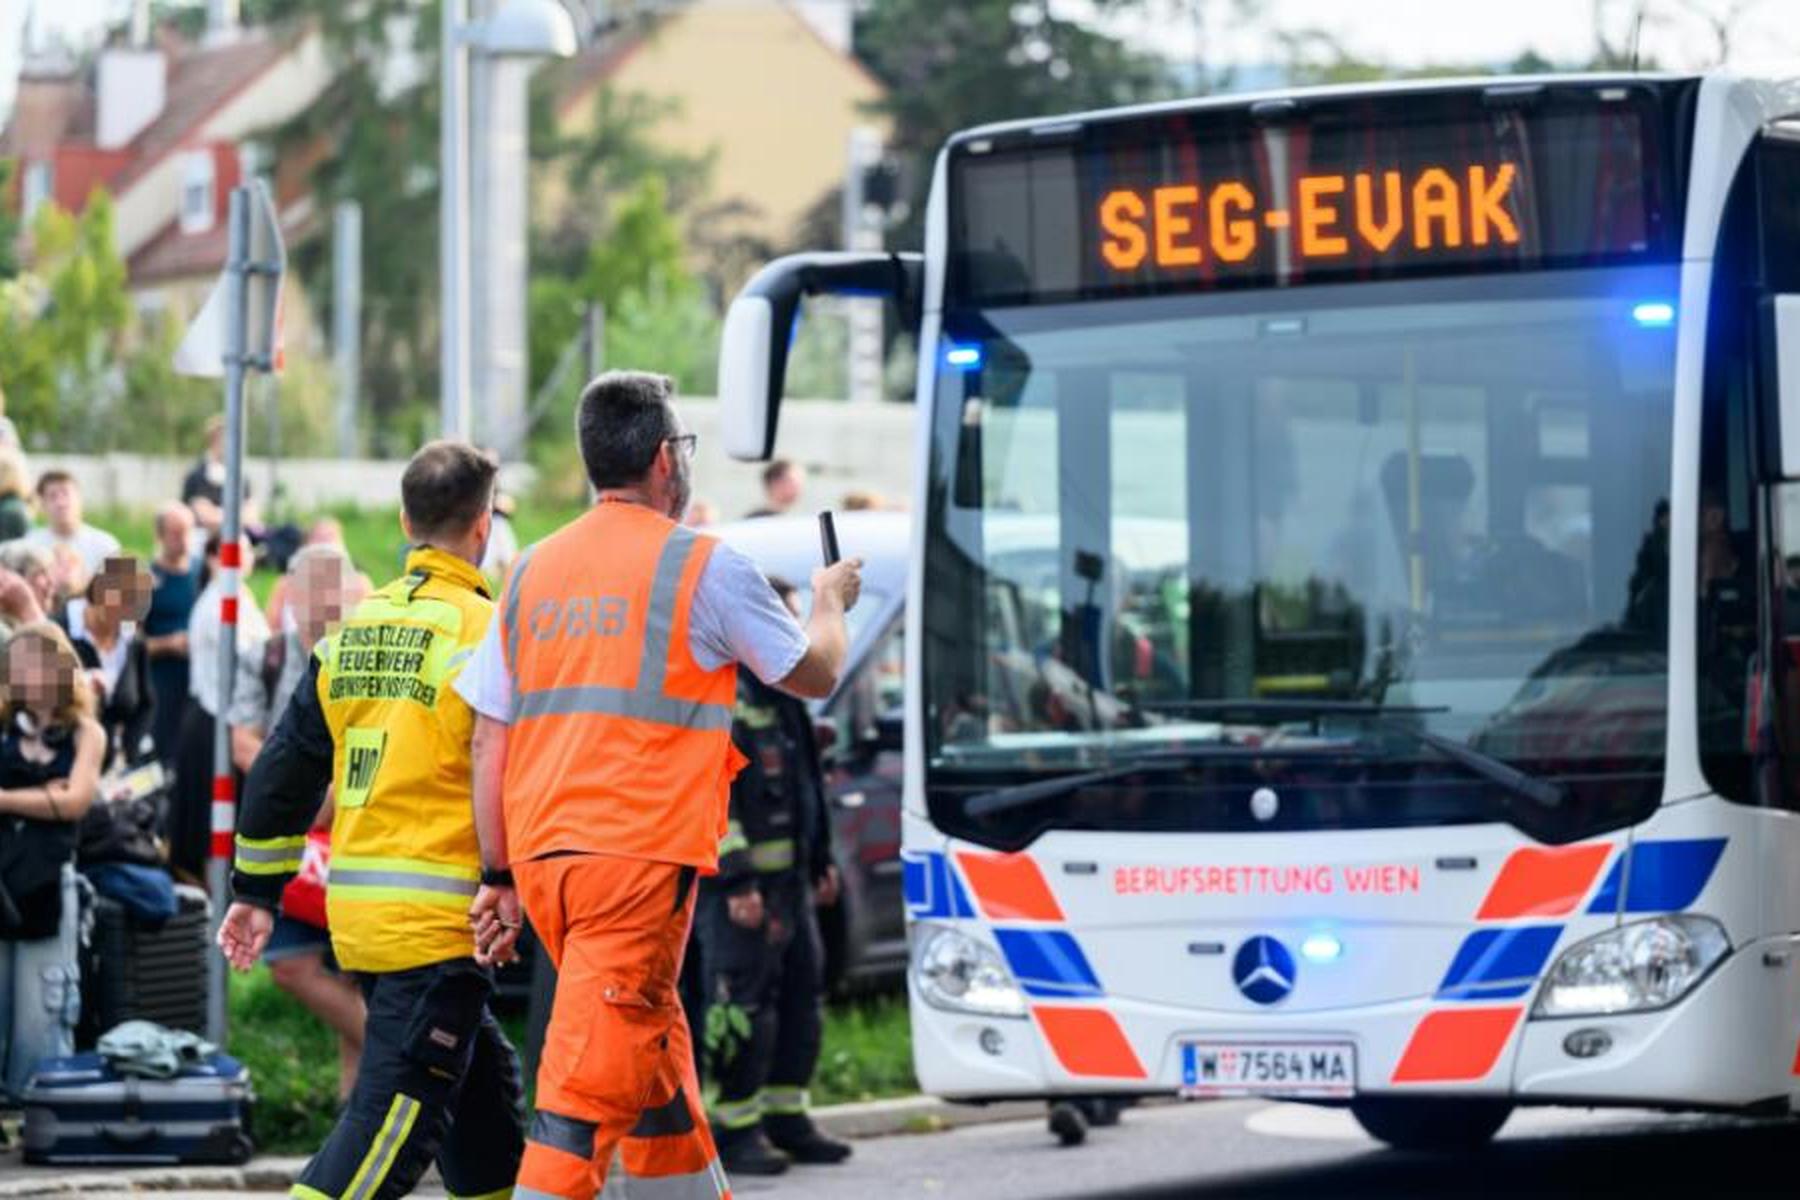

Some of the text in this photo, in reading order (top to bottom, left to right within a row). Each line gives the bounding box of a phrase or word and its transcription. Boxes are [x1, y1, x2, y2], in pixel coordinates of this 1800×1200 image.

[1100, 163, 1519, 269] SEG-EVAK
[338, 649, 424, 673] FEUERWEHR
[1114, 863, 1421, 896] BERUFSRETTUNG WIEN
[1239, 1052, 1304, 1081] 7564
[1310, 1052, 1345, 1080] MA
